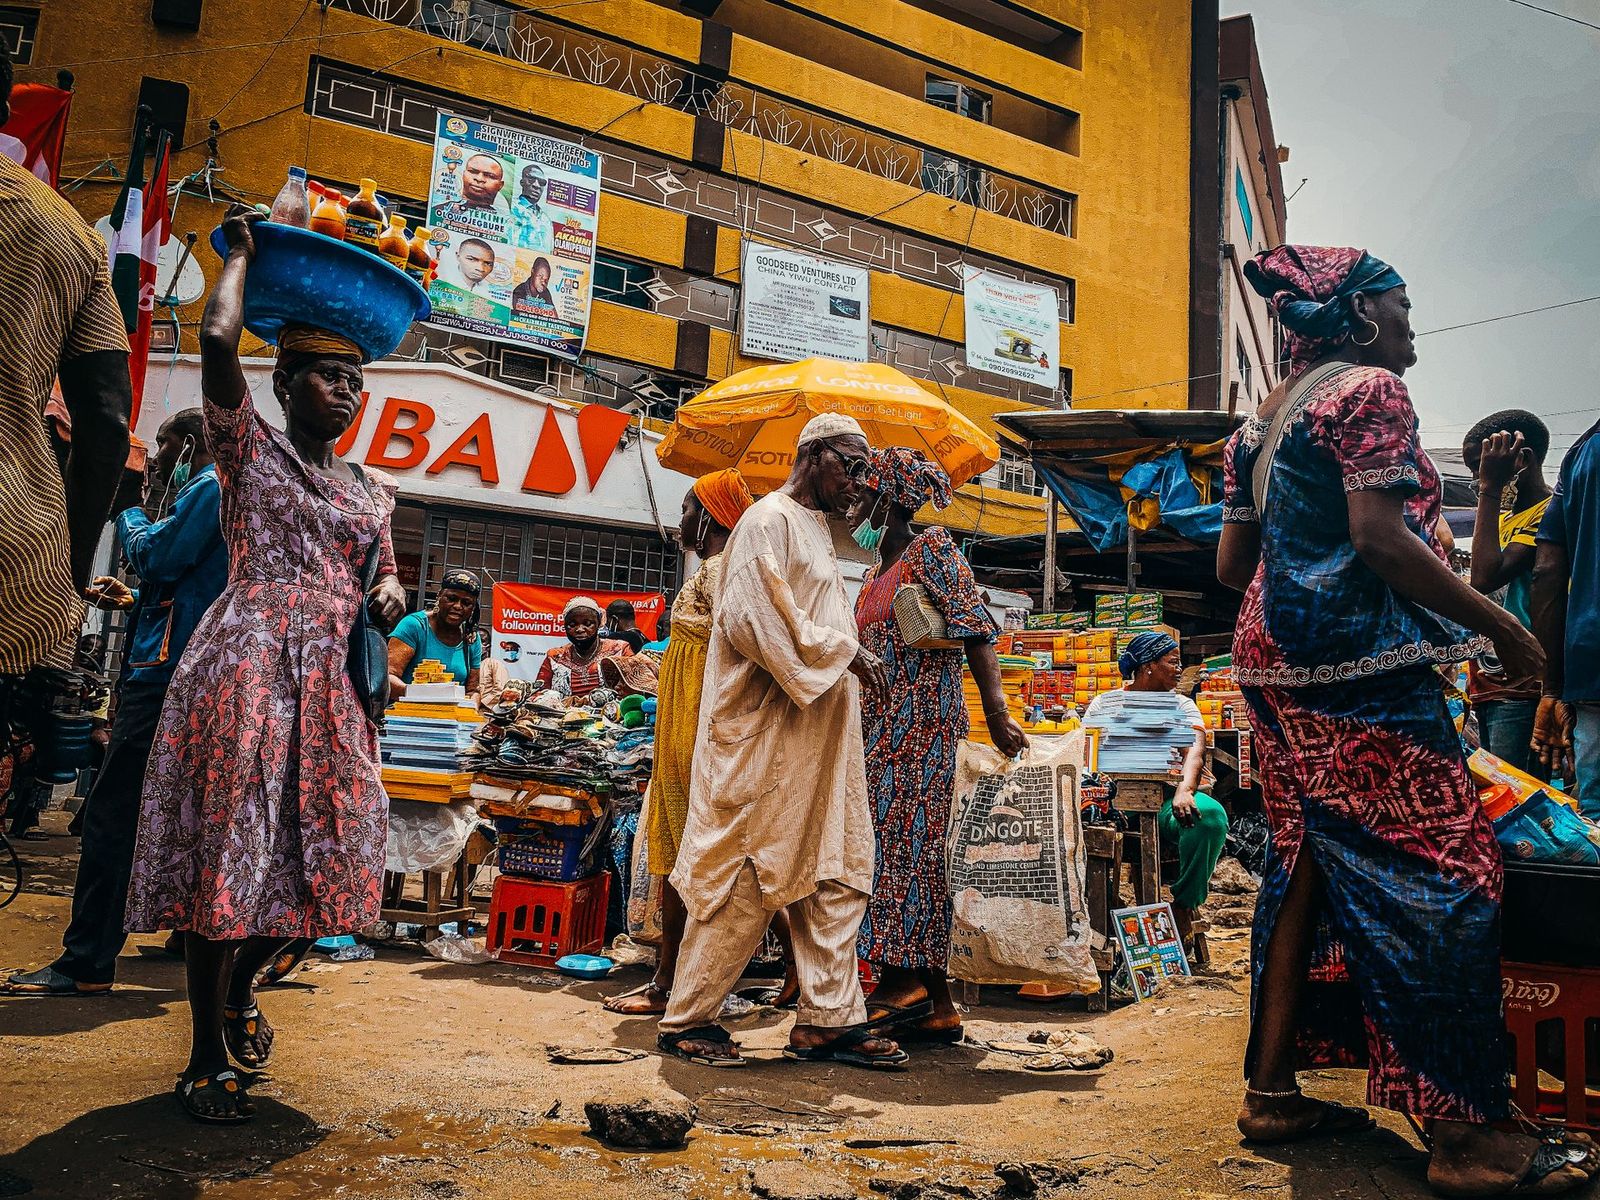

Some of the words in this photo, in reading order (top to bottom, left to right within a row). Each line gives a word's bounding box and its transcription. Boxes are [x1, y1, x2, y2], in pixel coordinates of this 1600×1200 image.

[474, 130, 521, 148] PRINTERS
[522, 142, 576, 165] ASSOCIATION
[578, 158, 591, 168] OF
[480, 124, 543, 146] SIGNWRITERS
[544, 140, 552, 148] &
[554, 142, 587, 160] SCREEN
[498, 144, 535, 161] NIGERIA
[536, 154, 572, 171] (SSPAN)
[436, 209, 505, 233] OLOWOJEGBURE
[468, 208, 504, 224] YEKINI
[555, 231, 592, 246] AKANNI
[756, 255, 799, 273] GOODSEED
[801, 265, 840, 282] VENTURES
[842, 276, 857, 286] LTD
[757, 265, 786, 278] CHINA
[788, 273, 811, 283] YIWU
[814, 278, 854, 293] CONTACT
[430, 315, 472, 329] ITESIWAJU
[816, 376, 922, 396] LONTOR
[823, 400, 841, 410] Get
[878, 404, 896, 416] Get
[898, 408, 922, 421] Light
[502, 608, 556, 623] Welcome,
[501, 620, 551, 633] following
[986, 862, 1018, 870] LIMESTONE
